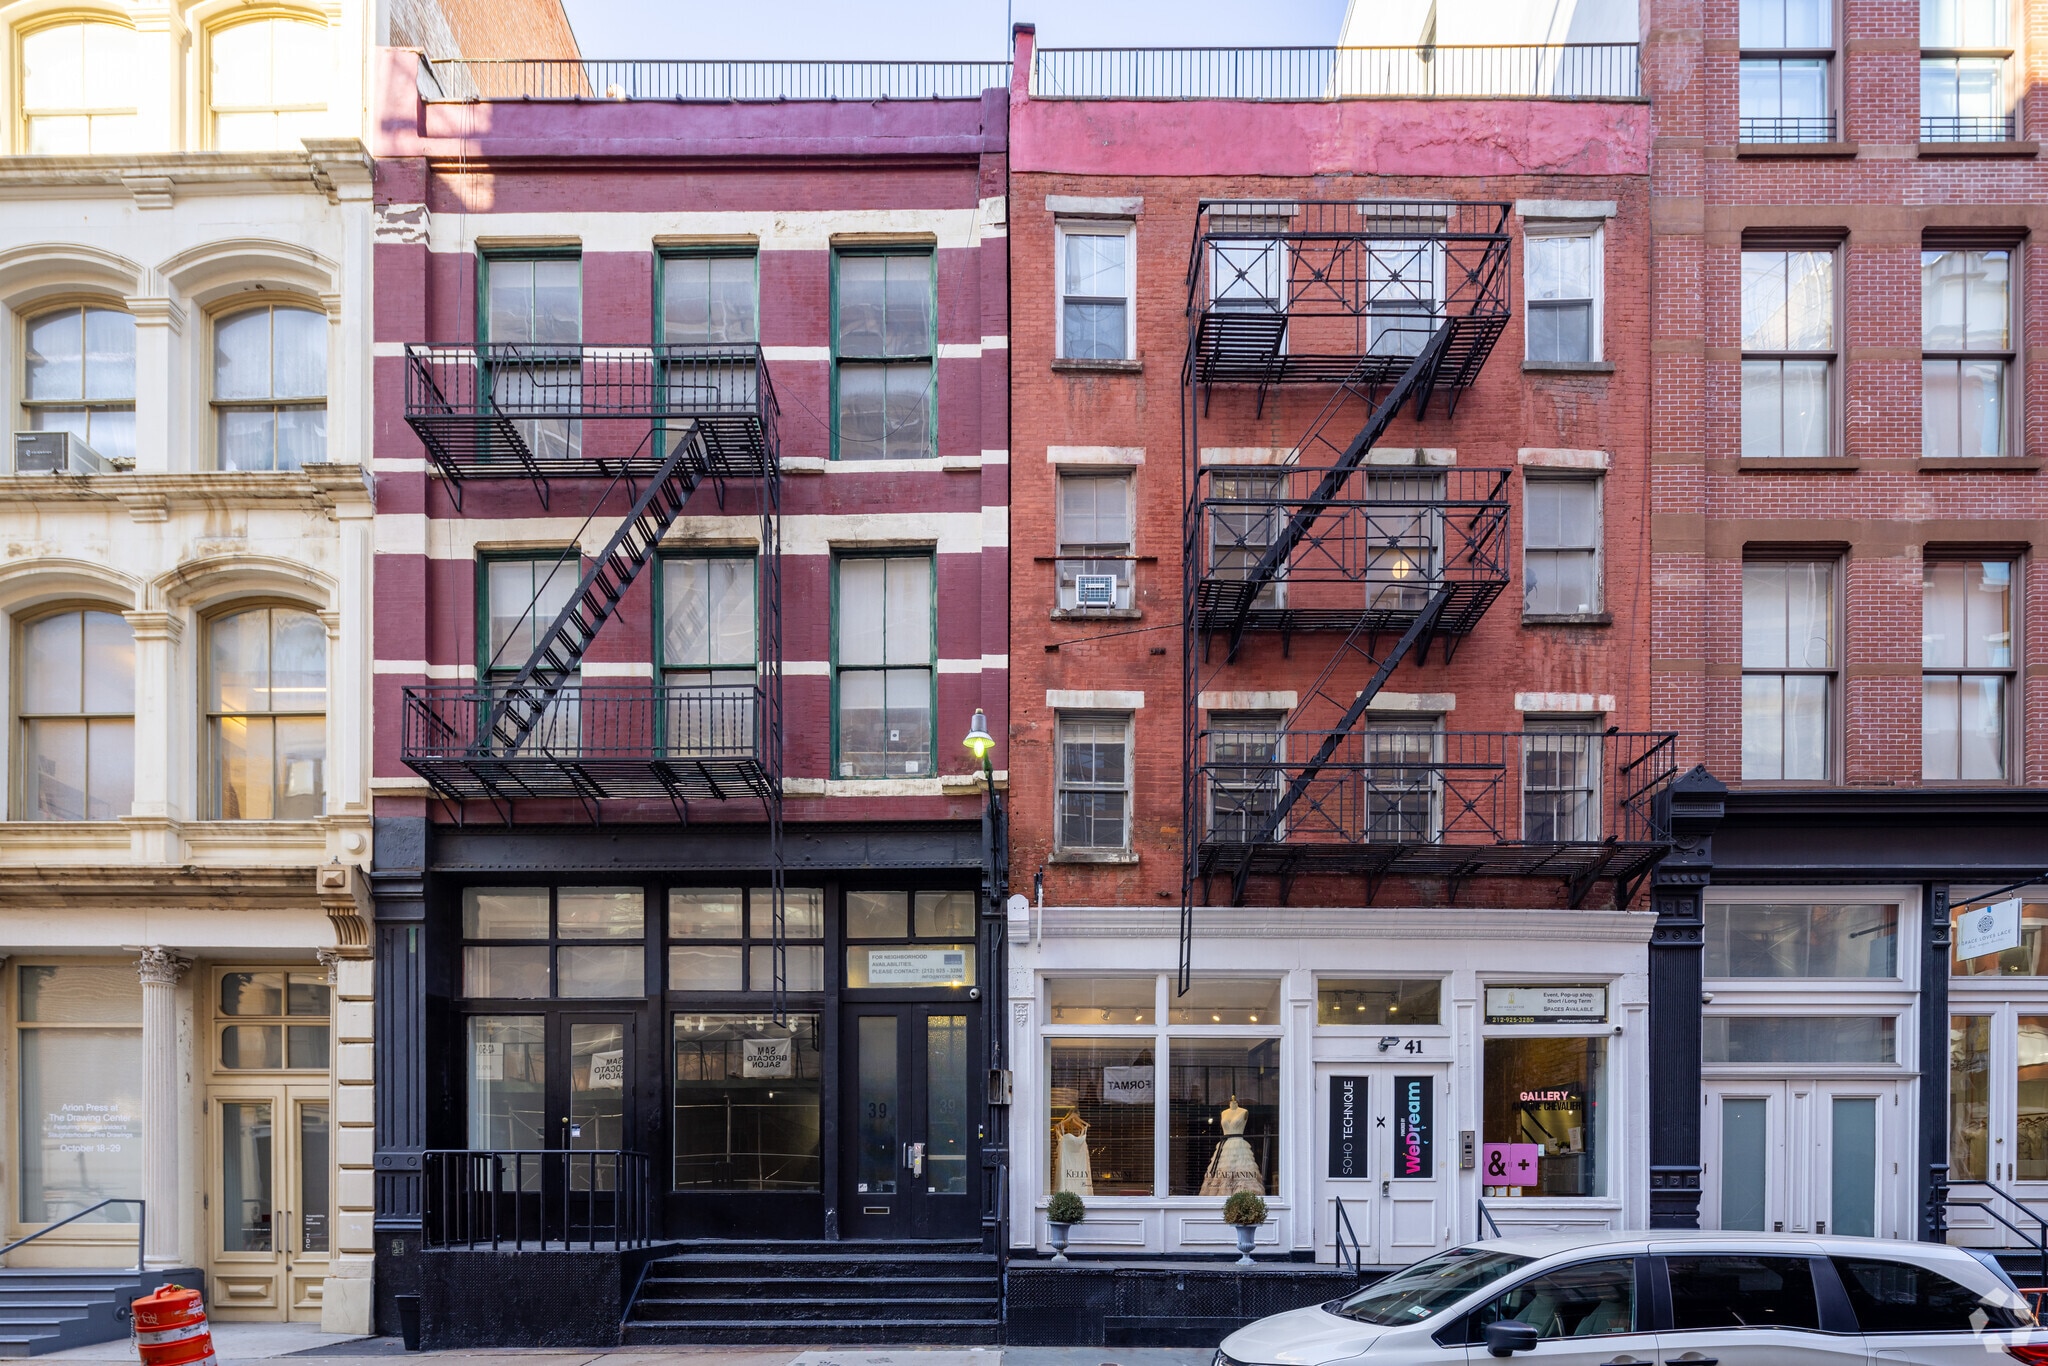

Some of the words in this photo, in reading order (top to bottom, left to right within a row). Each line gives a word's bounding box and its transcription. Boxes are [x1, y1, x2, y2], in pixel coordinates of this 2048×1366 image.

[1404, 1040, 1423, 1054] 41
[1519, 1091, 1569, 1102] GALLERY
[61, 1103, 84, 1112] Arion
[86, 1103, 109, 1112] Press
[110, 1104, 119, 1112] at
[868, 1102, 887, 1119] 39
[1343, 1080, 1354, 1140] TECHNIQUE
[1543, 1101, 1582, 1111] CHEVALIER
[49, 1113, 65, 1122] The
[66, 1113, 101, 1123] Drawing
[102, 1113, 131, 1122] Center
[1405, 1081, 1421, 1175] WeDream
[60, 1144, 94, 1153] October
[1342, 1142, 1353, 1175] SOHO
[1488, 1150, 1507, 1177] &
[1066, 1169, 1089, 1178] KELLY
